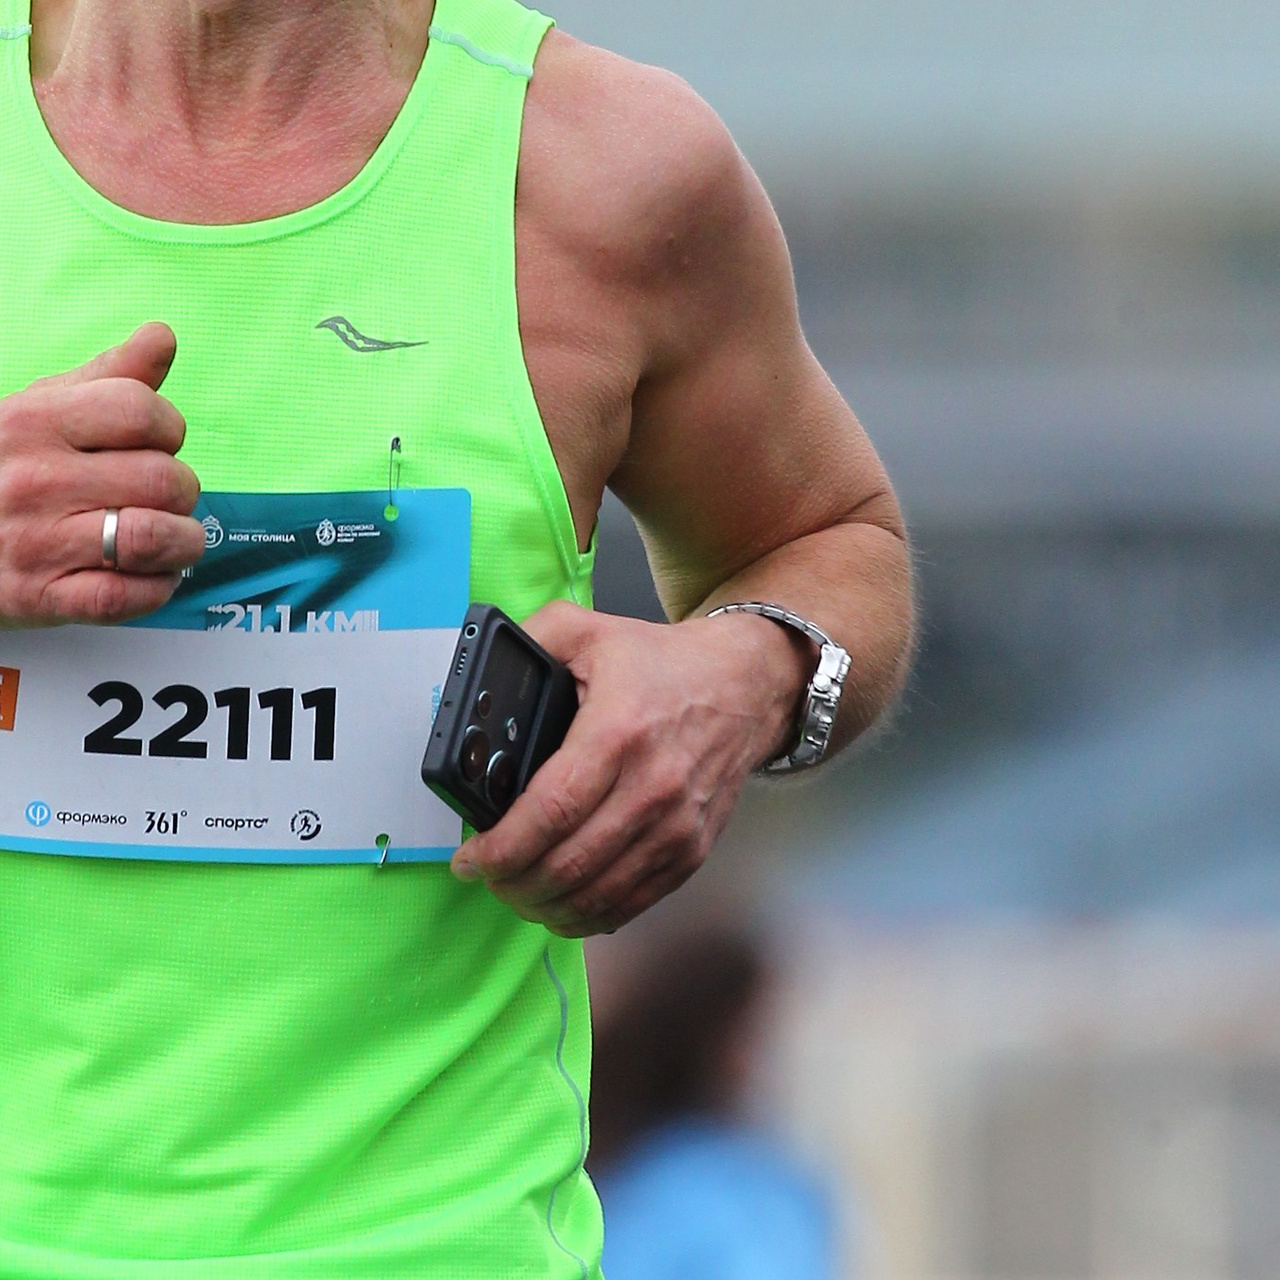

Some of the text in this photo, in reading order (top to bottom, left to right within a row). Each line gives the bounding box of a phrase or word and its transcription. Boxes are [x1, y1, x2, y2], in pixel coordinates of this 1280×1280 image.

[228, 533, 296, 544] МОЯ СТОЛИЦА
[220, 603, 291, 632] 21.1
[83, 680, 337, 761] 22111
[56, 811, 128, 826] фармэко
